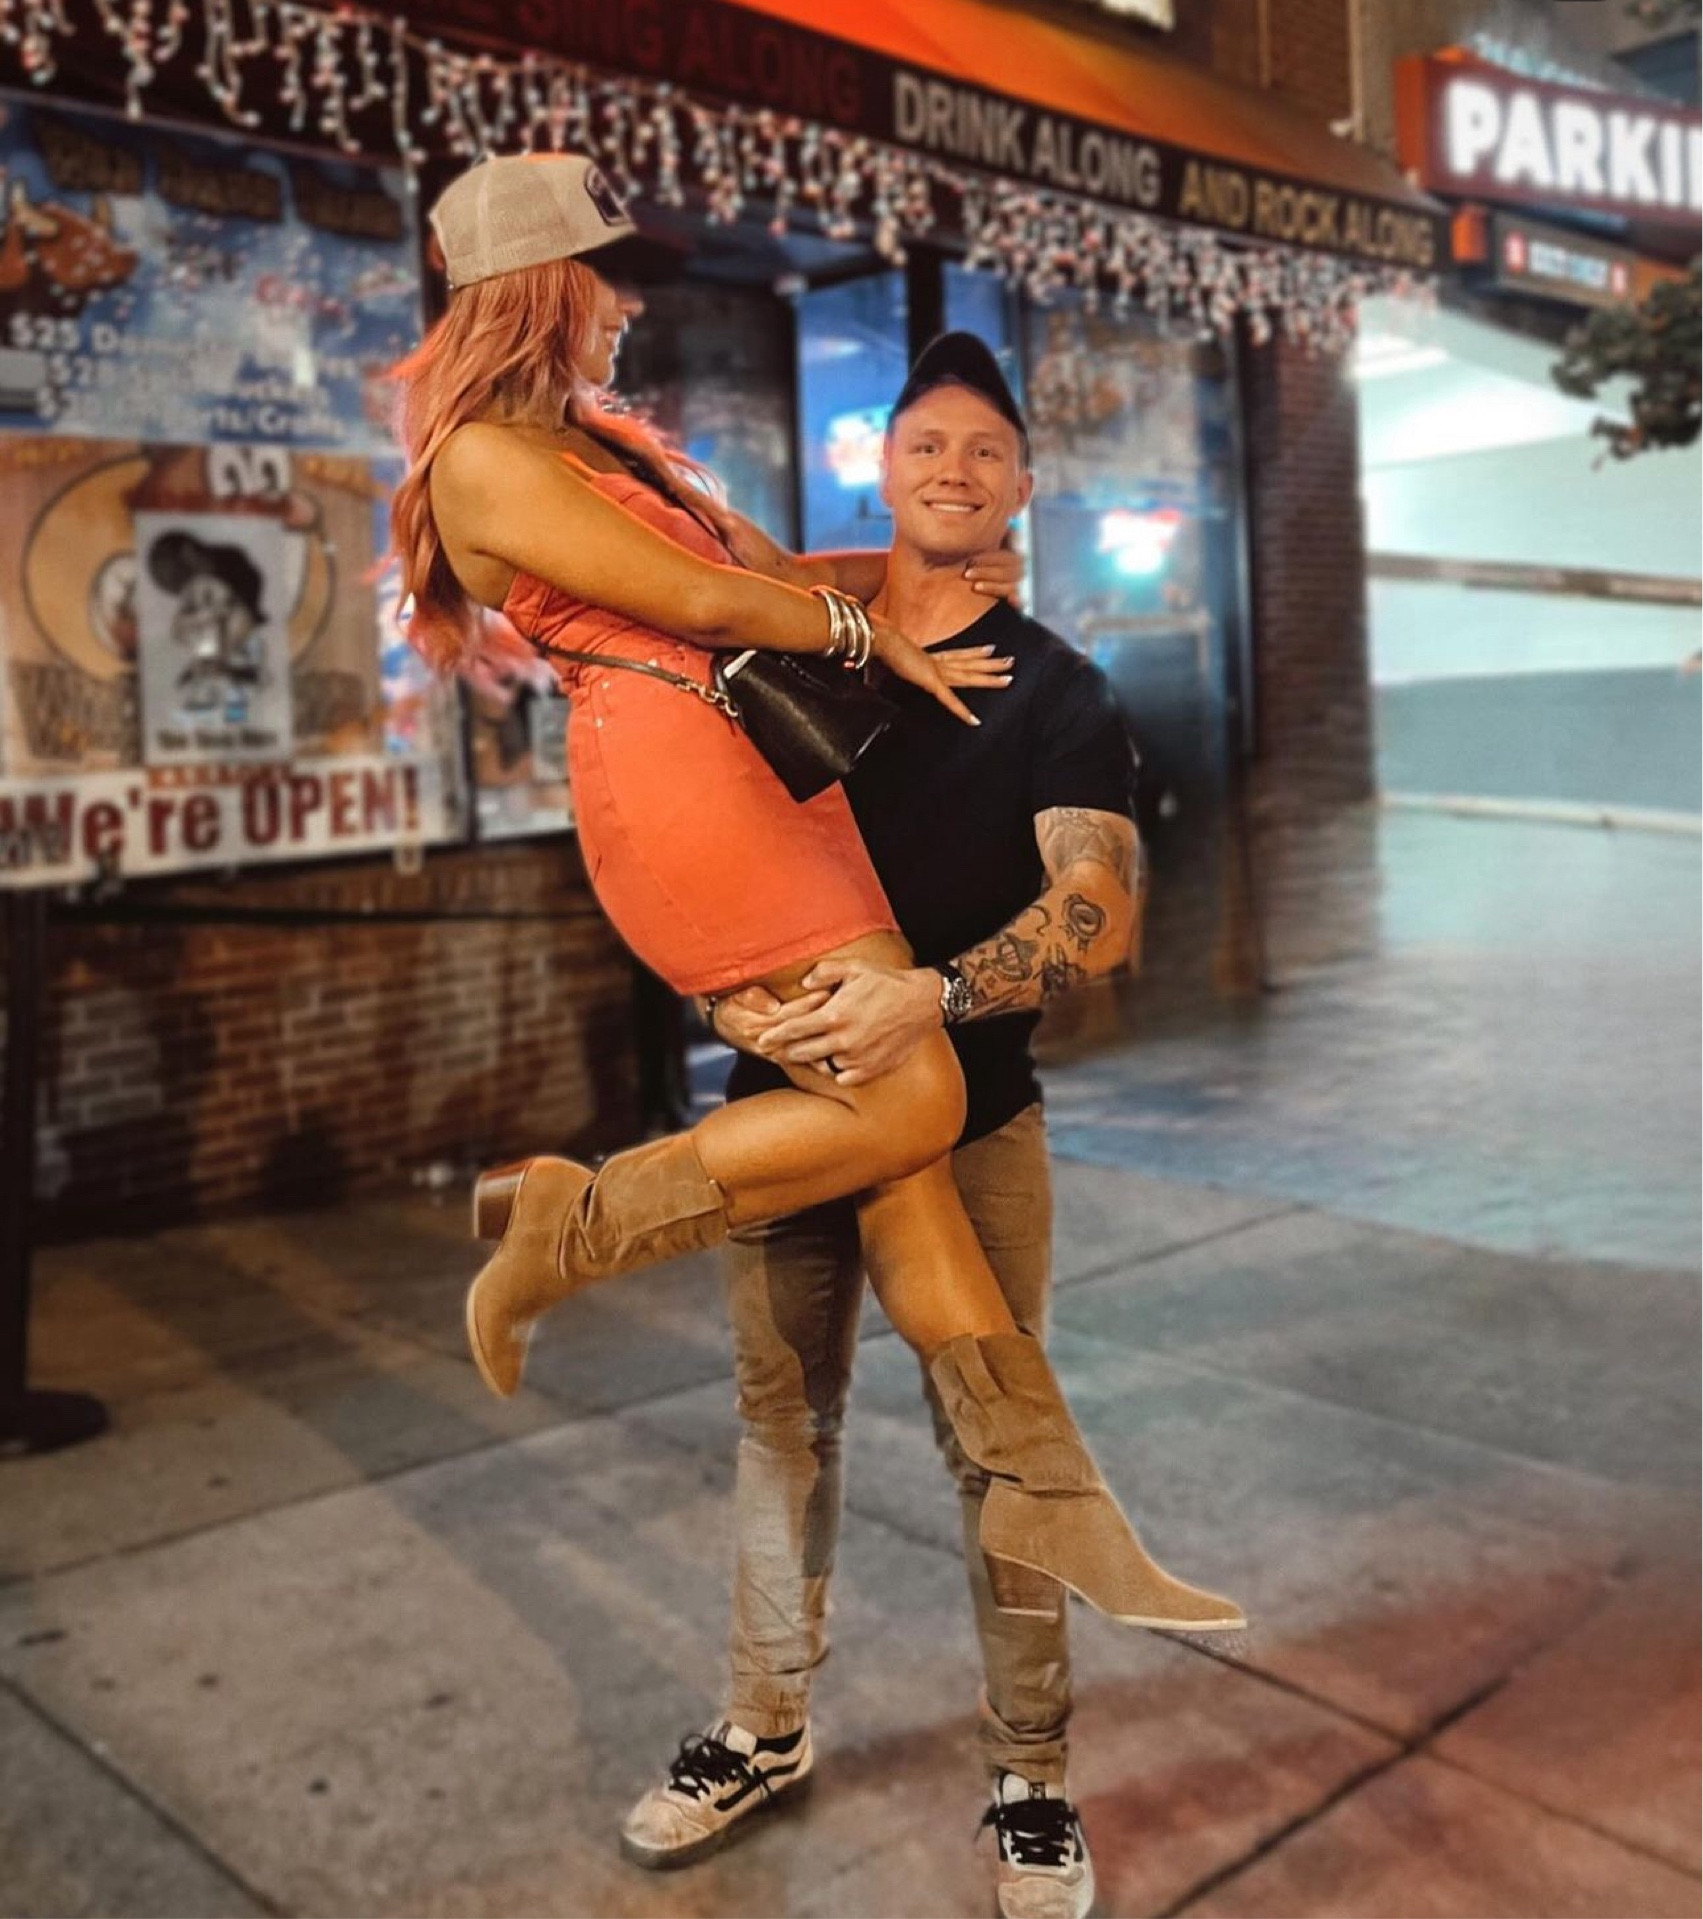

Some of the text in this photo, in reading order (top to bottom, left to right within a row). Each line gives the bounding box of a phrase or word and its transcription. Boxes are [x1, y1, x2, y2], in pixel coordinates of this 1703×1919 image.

[682, 7, 860, 121] ALONG
[894, 71, 1026, 171] DRINK
[1032, 116, 1161, 206] ALONG
[1179, 162, 1248, 230] AND
[1255, 180, 1340, 252] ROCK
[1341, 199, 1435, 266] ALONG
[241, 765, 421, 846] OPEN!
